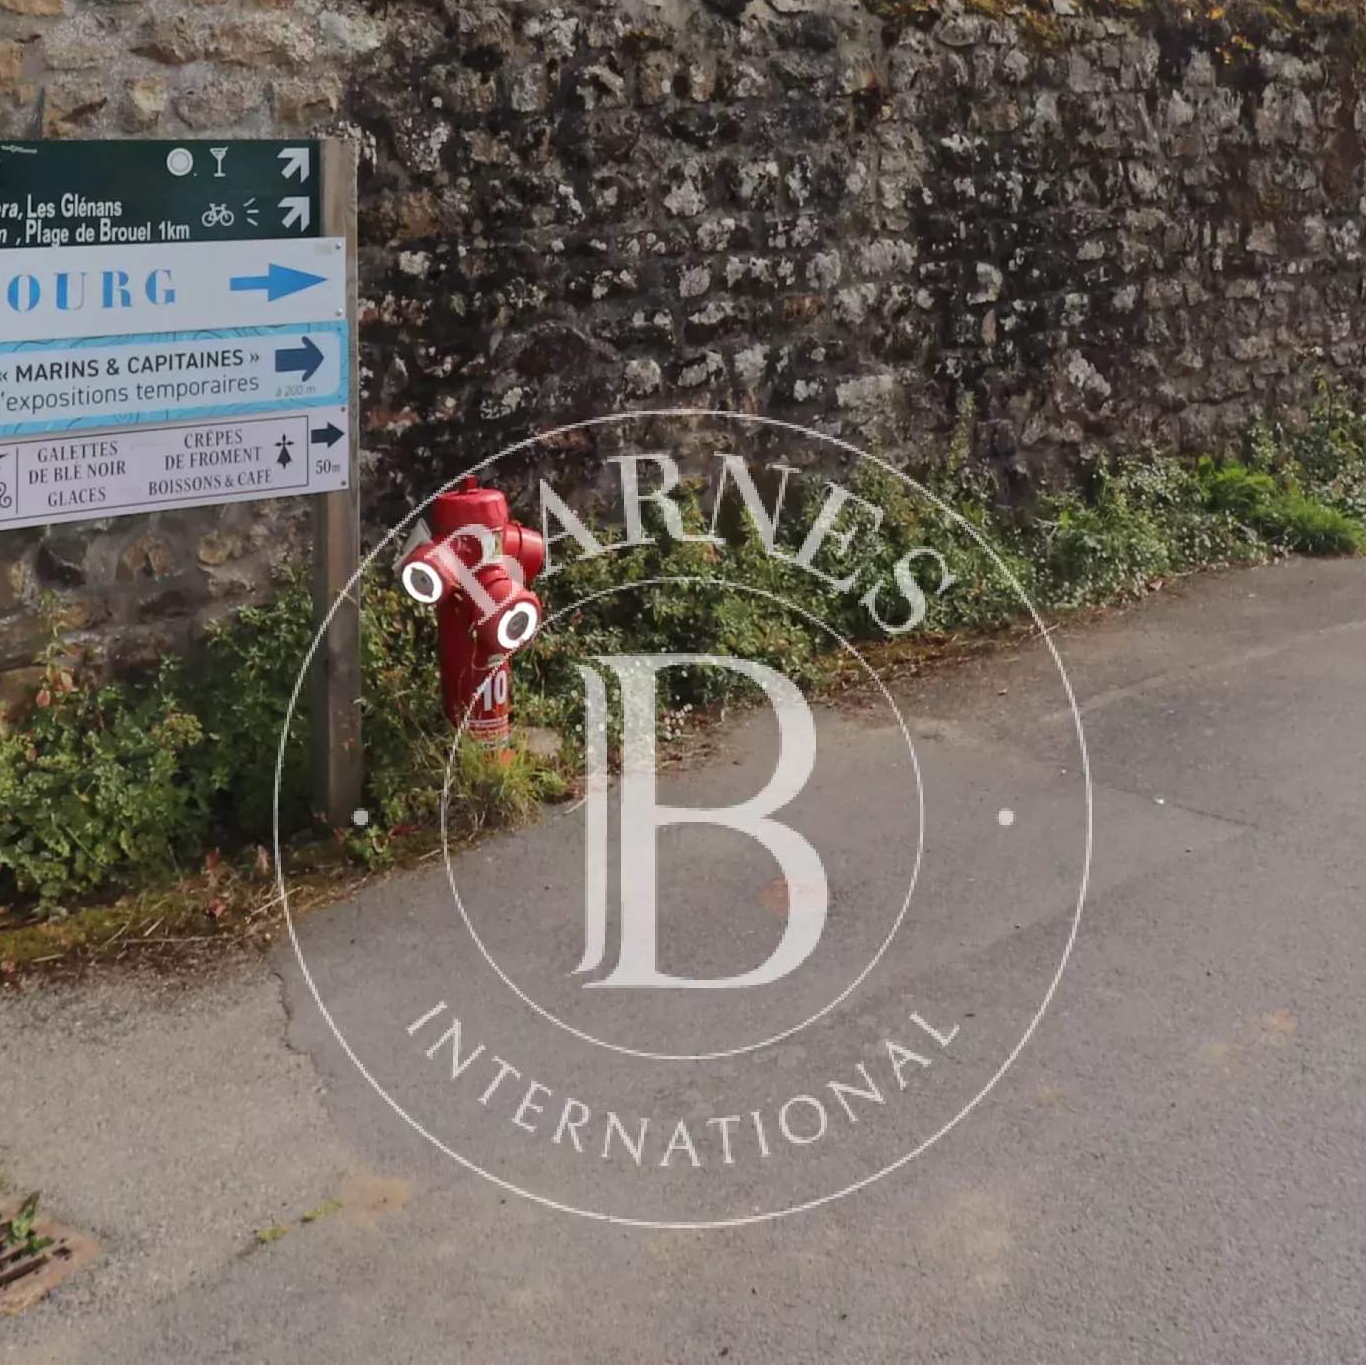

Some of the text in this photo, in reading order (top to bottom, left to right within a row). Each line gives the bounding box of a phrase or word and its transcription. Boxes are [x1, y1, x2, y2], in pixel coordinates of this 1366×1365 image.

[26, 194, 55, 218] Les
[60, 192, 123, 218] Glénans
[25, 219, 69, 247] Plage
[75, 223, 95, 243] de
[99, 218, 151, 243] Brouel
[158, 221, 191, 240] 1km
[15, 360, 99, 383] MARINS
[106, 358, 120, 375] &
[127, 349, 244, 374] CAPITAINES
[136, 374, 260, 402] temporaires
[37, 440, 119, 463] GALETTES
[184, 429, 243, 449] CRÊPES
[165, 446, 263, 471] DE FROMENT
[28, 468, 49, 485] DE
[87, 460, 127, 478] NOIR
[148, 474, 221, 496] BOISSONS
[225, 476, 234, 487] &
[47, 487, 107, 507] GLACES
